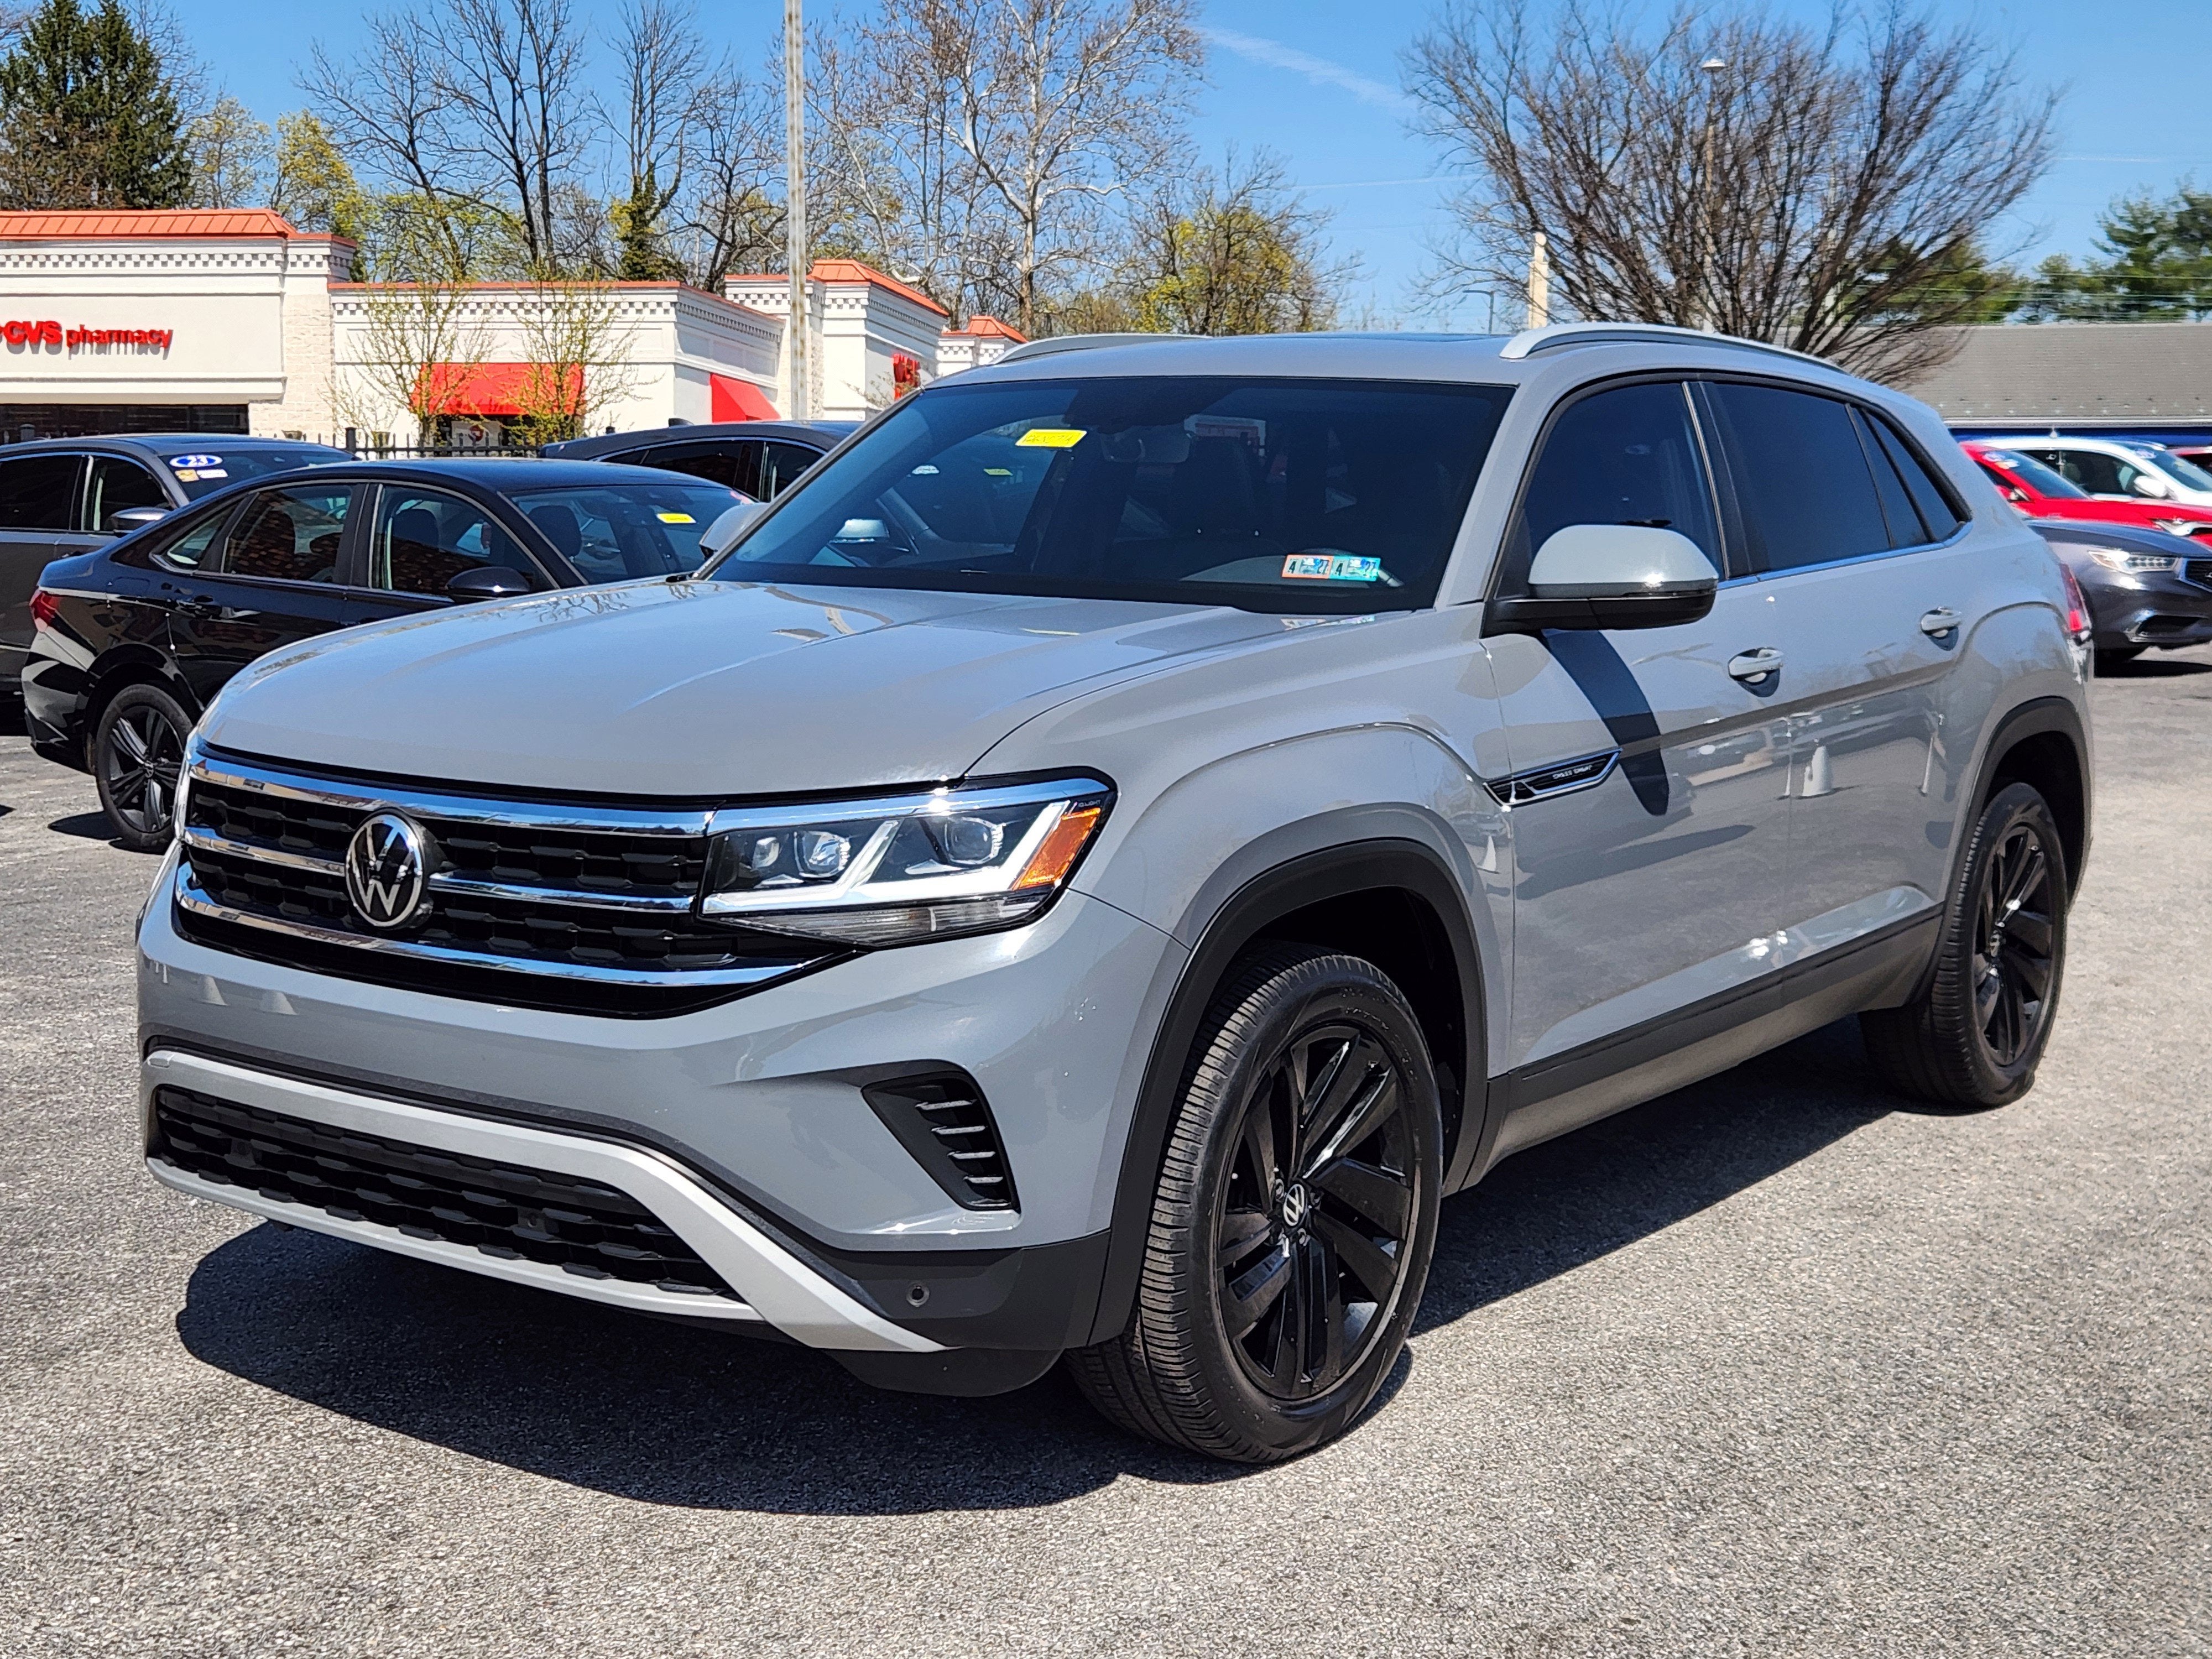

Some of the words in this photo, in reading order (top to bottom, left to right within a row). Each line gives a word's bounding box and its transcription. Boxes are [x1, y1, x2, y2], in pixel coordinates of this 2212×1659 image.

[4, 320, 62, 345] CVS
[66, 324, 173, 348] pharmacy
[187, 455, 208, 467] 23
[1288, 561, 1297, 574] 4
[1335, 562, 1343, 576] 4
